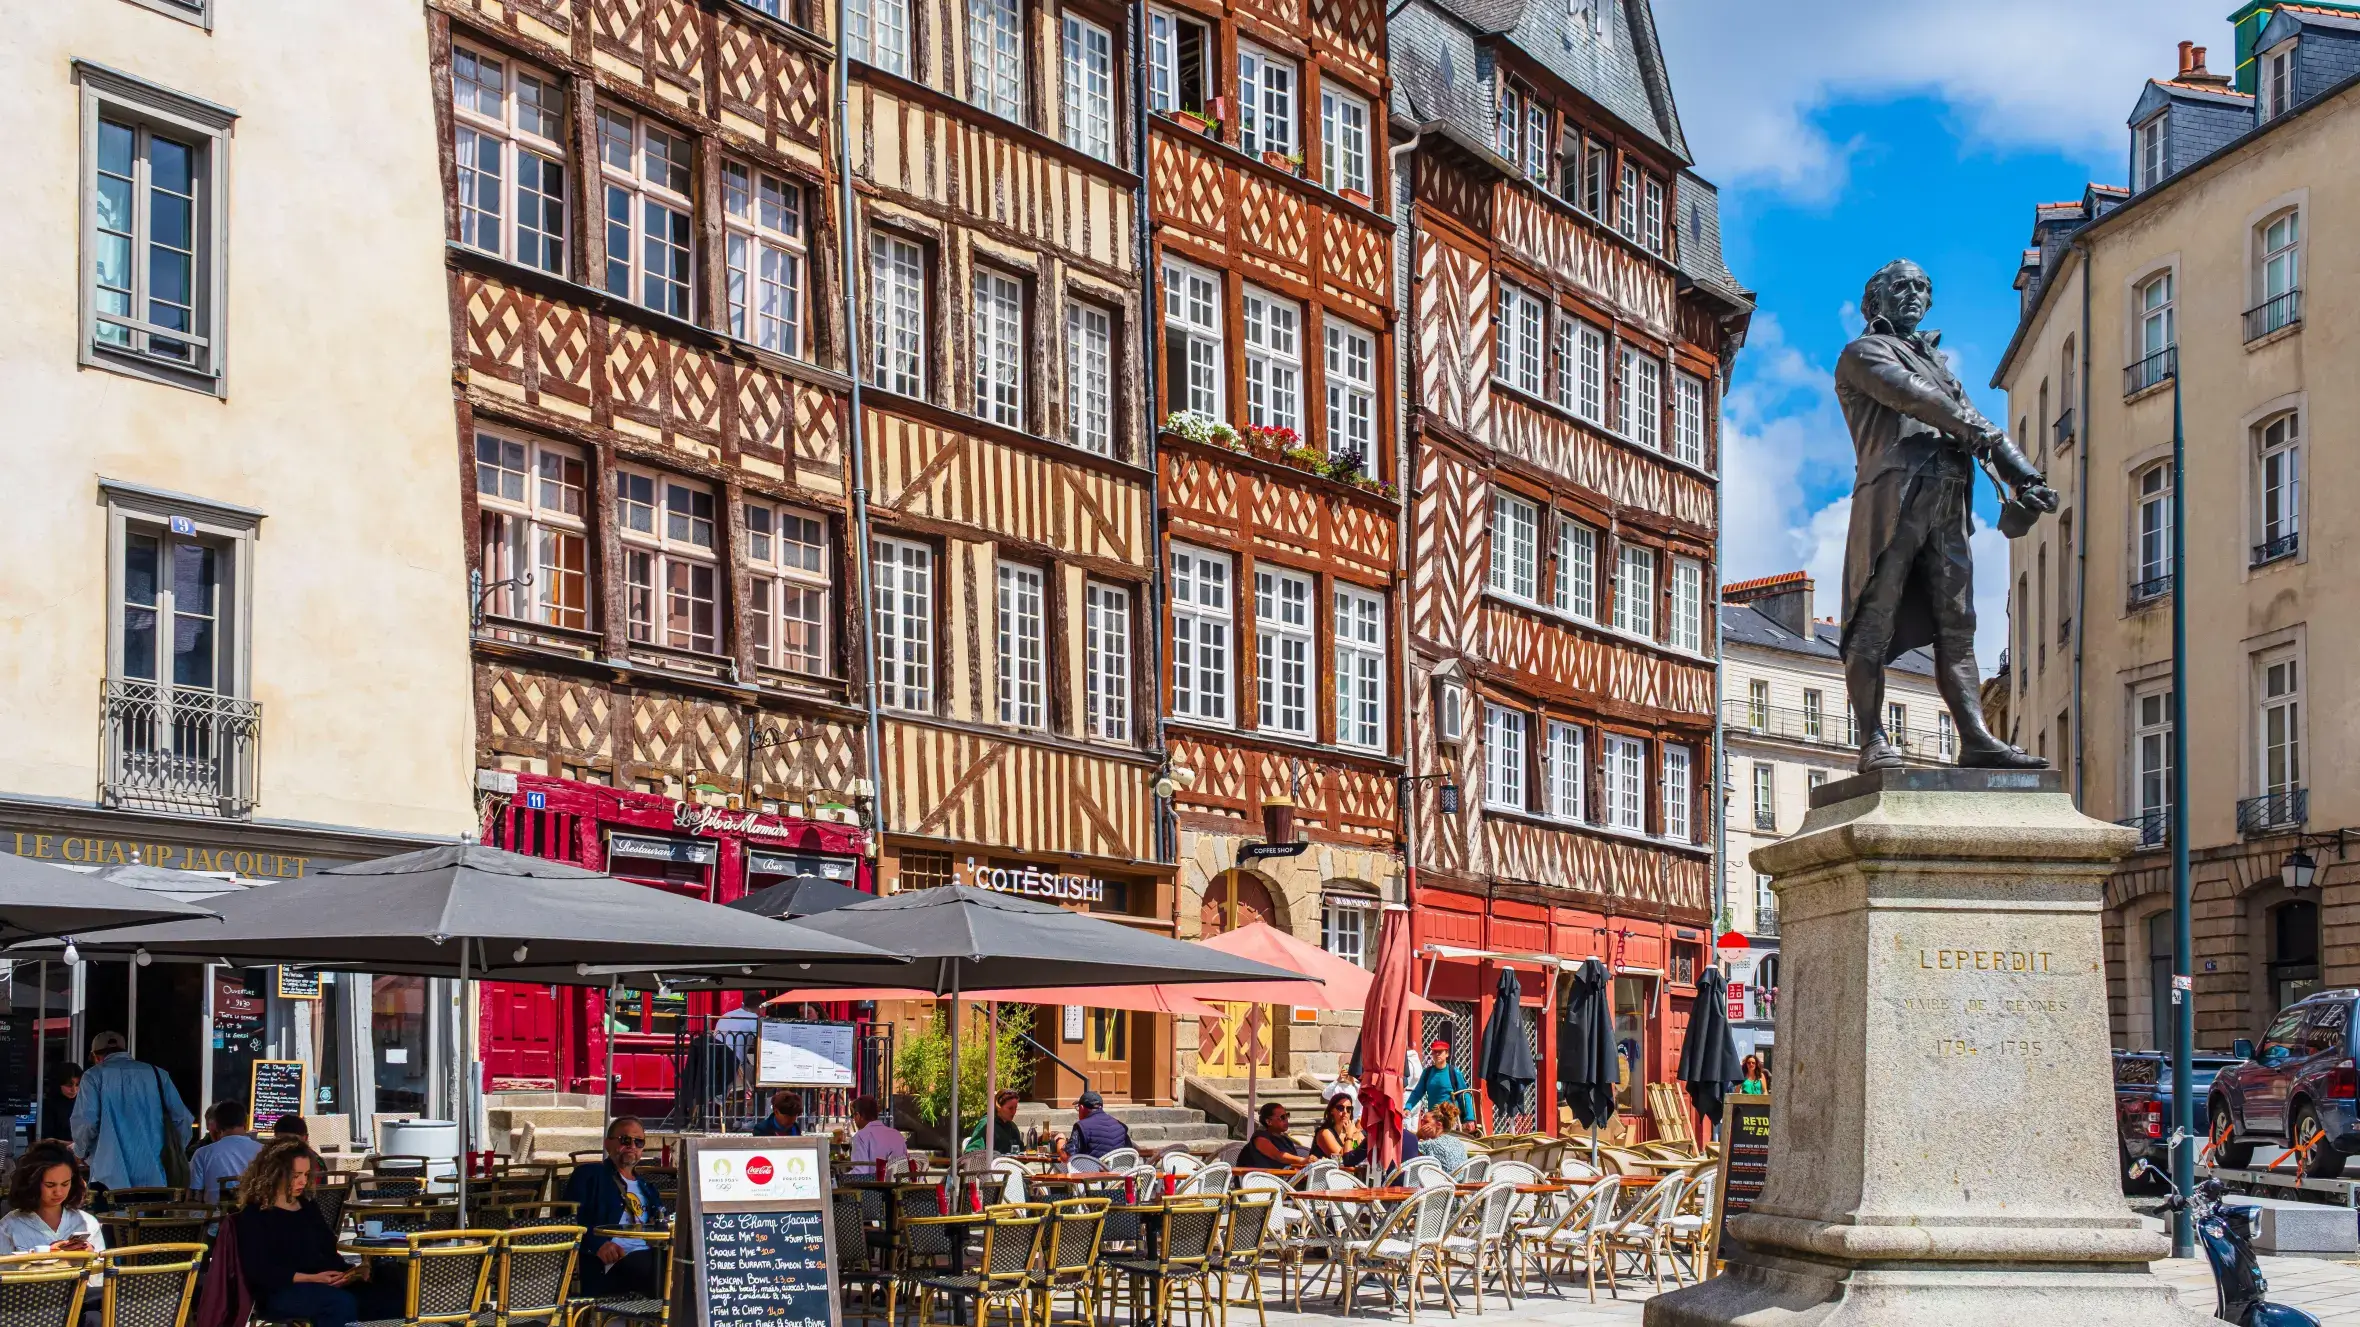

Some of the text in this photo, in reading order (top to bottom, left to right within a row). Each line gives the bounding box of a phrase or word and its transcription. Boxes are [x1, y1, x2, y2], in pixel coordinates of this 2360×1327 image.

[178, 518, 189, 533] 9
[530, 793, 541, 808] 11
[674, 801, 699, 828] Les
[692, 806, 722, 836] fils
[733, 813, 789, 838] Maman
[618, 839, 676, 858] Restaurant
[1253, 847, 1277, 855] COFFEE
[14, 832, 310, 880] LE CHAMP JACQUET
[763, 858, 783, 872] Bar
[1919, 949, 2052, 972] LEPERDIT
[1968, 999, 1987, 1011] DE
[2006, 999, 2068, 1012] RENNES
[1936, 1039, 1978, 1056] 1794
[2000, 1040, 2043, 1057] 1795
[1743, 1116, 1770, 1126] RETO
[1755, 1127, 1770, 1137] EN
[747, 1165, 773, 1175] Coca-Cola
[713, 1213, 820, 1234] Le Champ Jacquet
[709, 1231, 735, 1242] CROQUE
[709, 1246, 737, 1257] CROQUE
[709, 1259, 736, 1270] SALADE
[774, 1258, 802, 1270] JAMBON
[804, 1258, 816, 1270] SEC
[710, 1272, 796, 1286] MEXICAN BOWL 13,00
[713, 1305, 785, 1317] FISH & CHIPS 14,00
